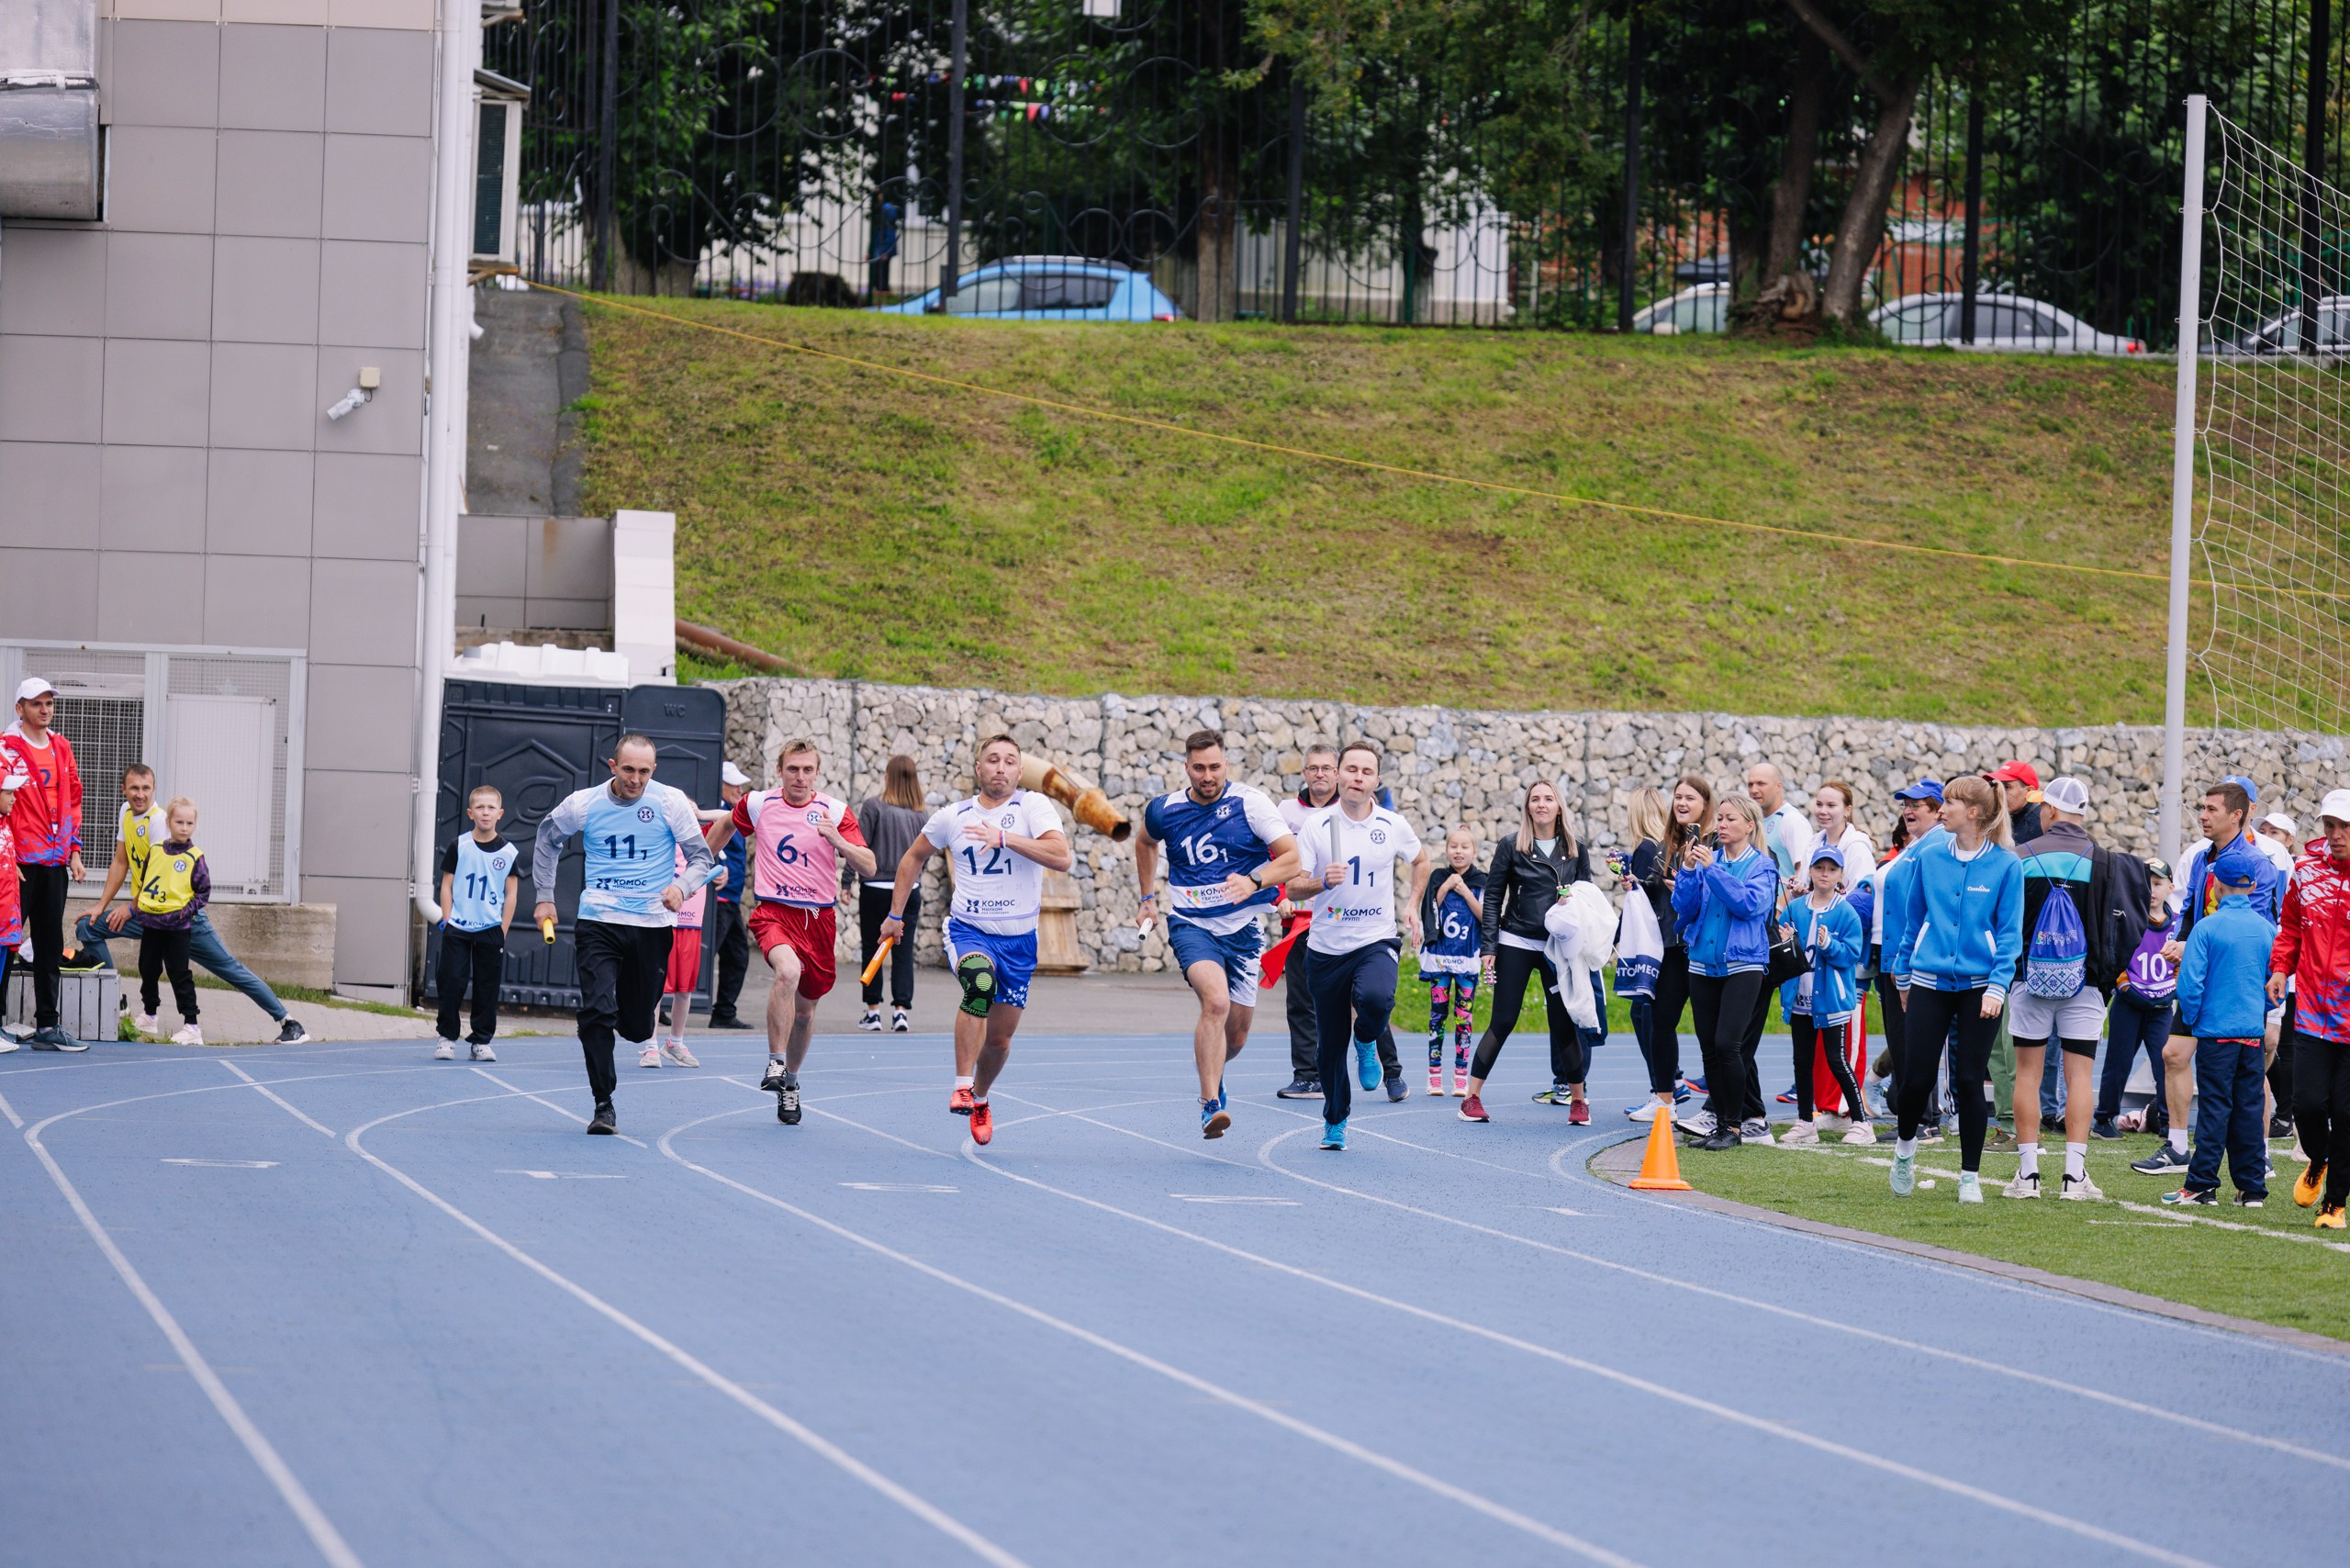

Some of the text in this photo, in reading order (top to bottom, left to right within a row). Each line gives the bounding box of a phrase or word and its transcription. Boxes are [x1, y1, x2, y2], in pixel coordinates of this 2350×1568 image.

[777, 834, 799, 865] 6
[613, 879, 647, 887] КОМОС
[981, 899, 1015, 908] КОМОС
[1342, 907, 1382, 917] КОМОС
